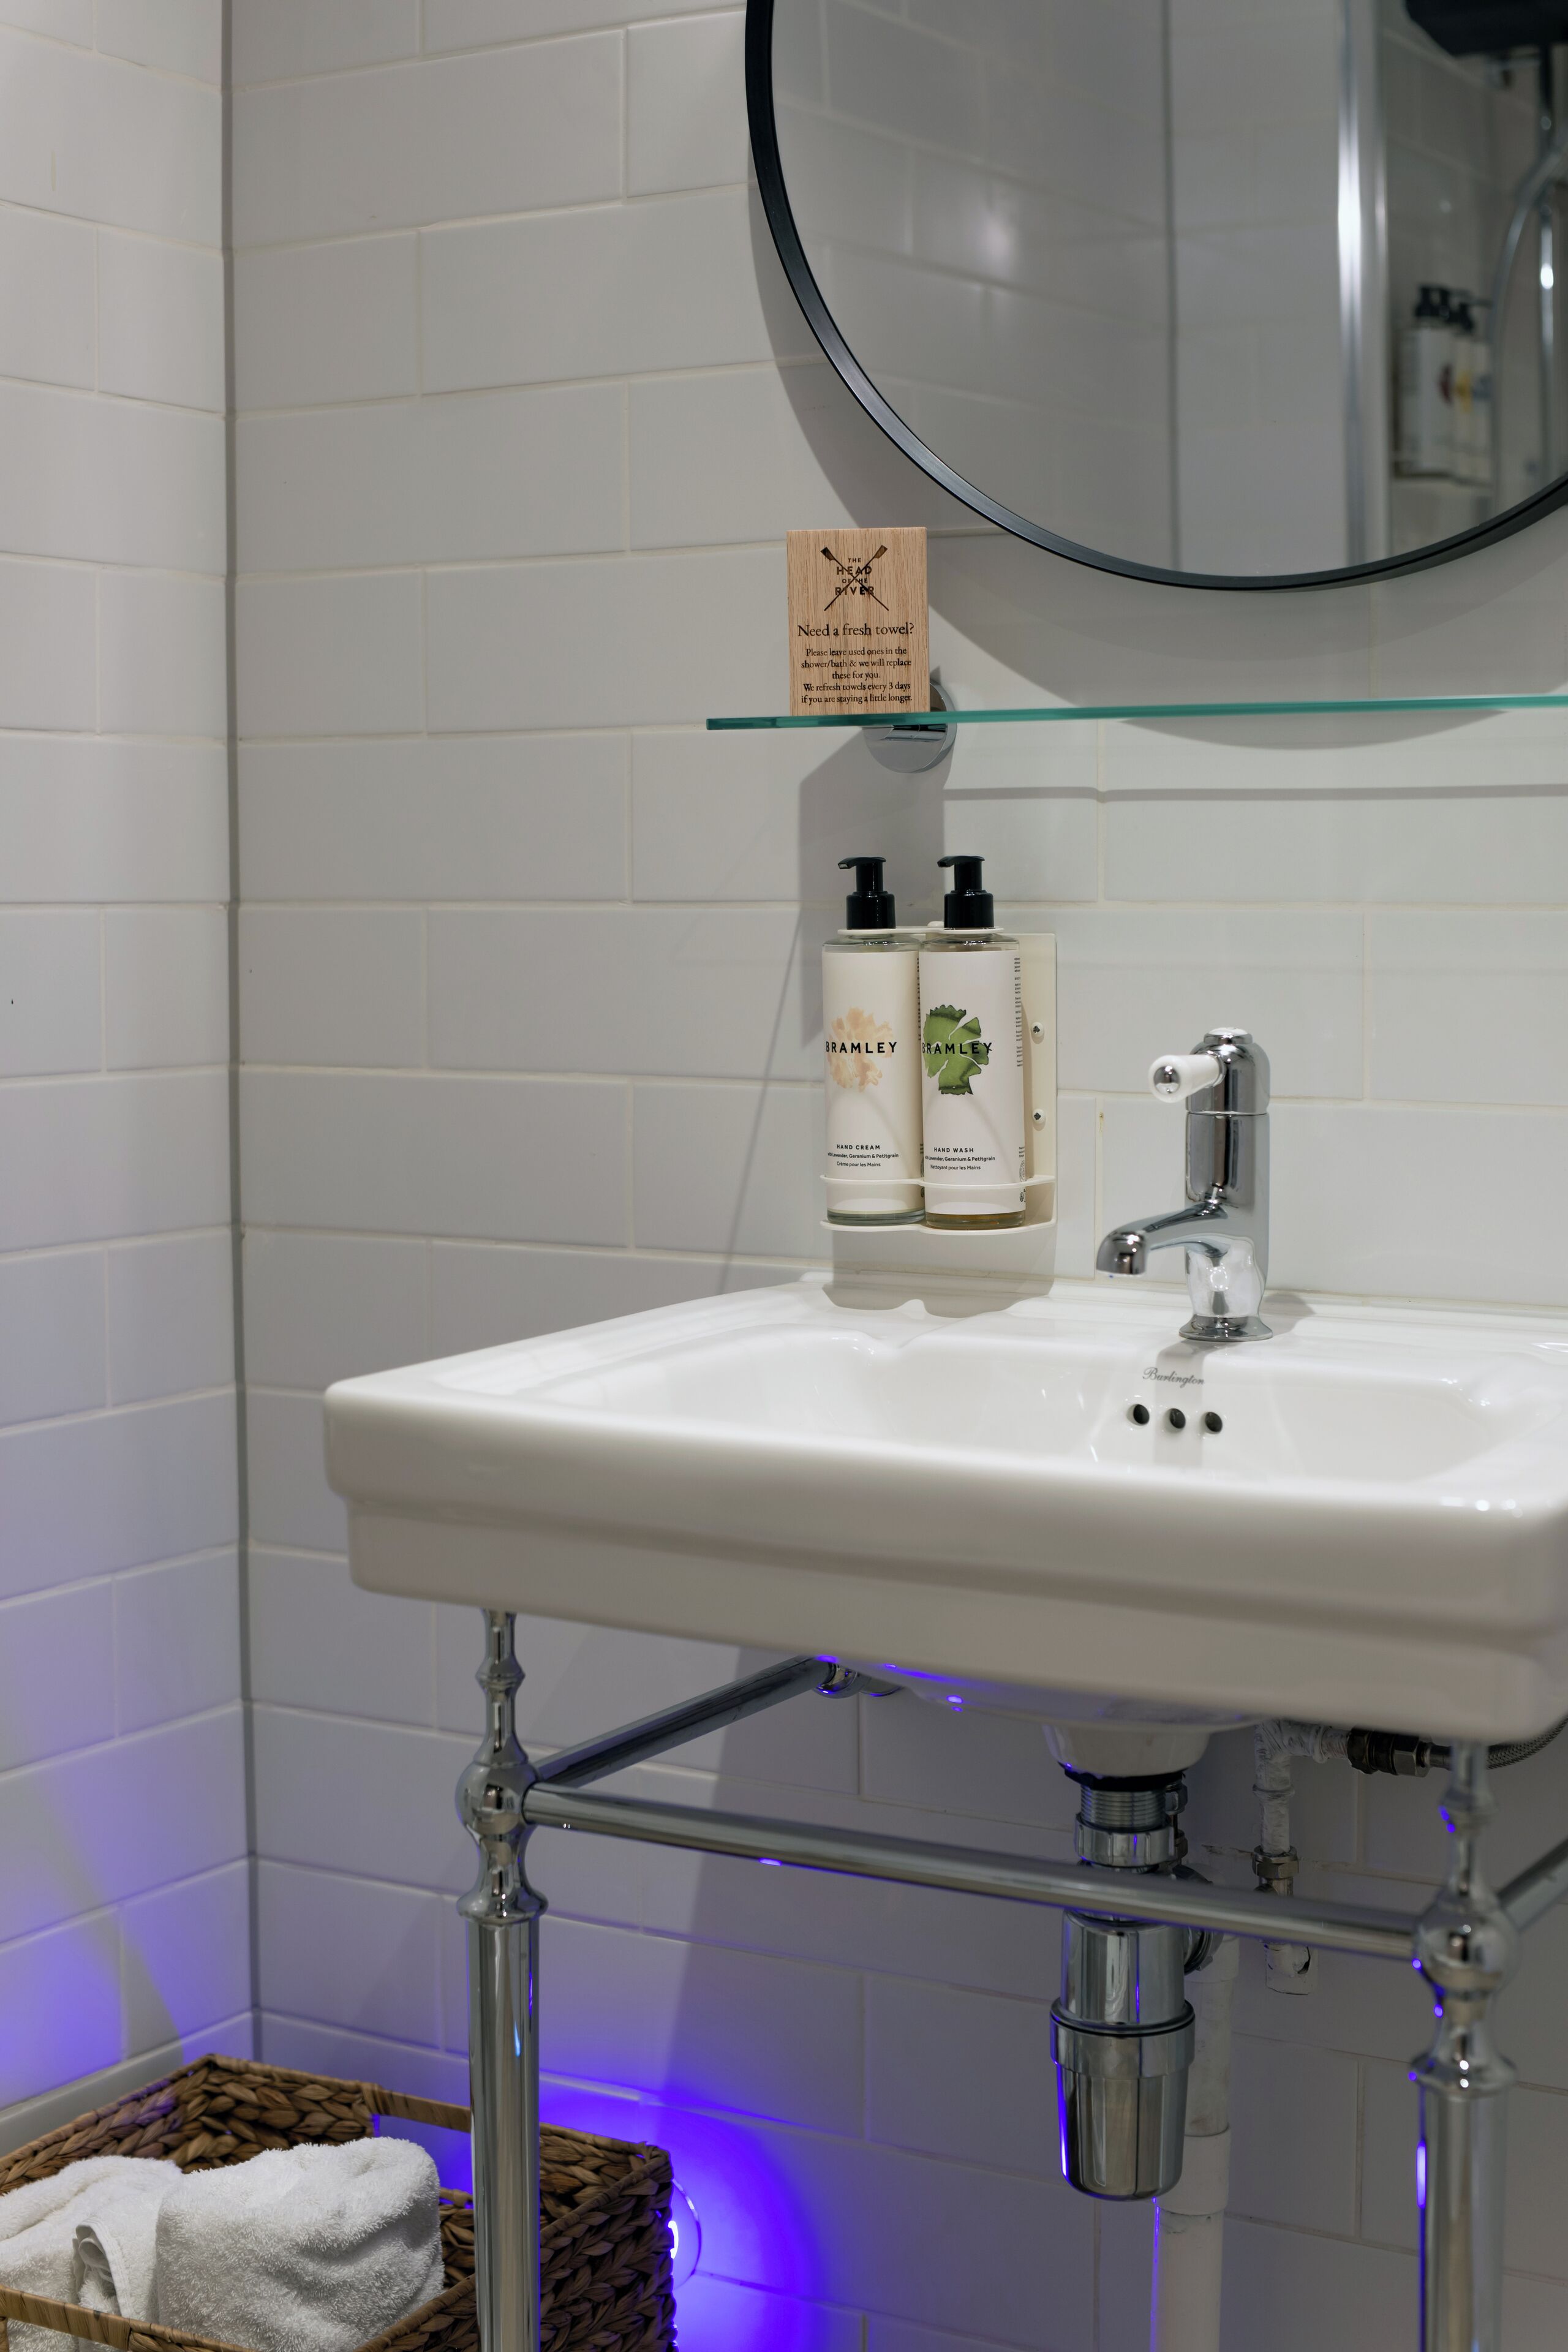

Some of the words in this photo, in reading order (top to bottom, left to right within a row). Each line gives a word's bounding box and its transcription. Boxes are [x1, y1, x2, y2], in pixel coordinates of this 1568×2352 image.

[837, 566, 872, 575] HEAD
[835, 586, 875, 596] RIVER
[797, 624, 830, 637] Need
[842, 623, 872, 636] fresh
[876, 622, 914, 635] towel?
[806, 648, 827, 657] Please
[829, 647, 846, 656] leave
[849, 647, 865, 655] used
[895, 646, 907, 655] the
[801, 660, 847, 668] shower/bath
[886, 658, 911, 669] replace
[865, 673, 880, 681] you.
[803, 683, 815, 692] We
[816, 682, 840, 691] refresh
[843, 682, 866, 691] towels
[895, 681, 911, 692] days
[809, 697, 823, 706] you
[837, 695, 862, 704] staying
[870, 693, 886, 702] little
[888, 693, 912, 704] longer.
[826, 1041, 897, 1054] BRAMLEY
[922, 1042, 992, 1054] BRAMLEY
[1142, 1366, 1205, 1389] Burlington
